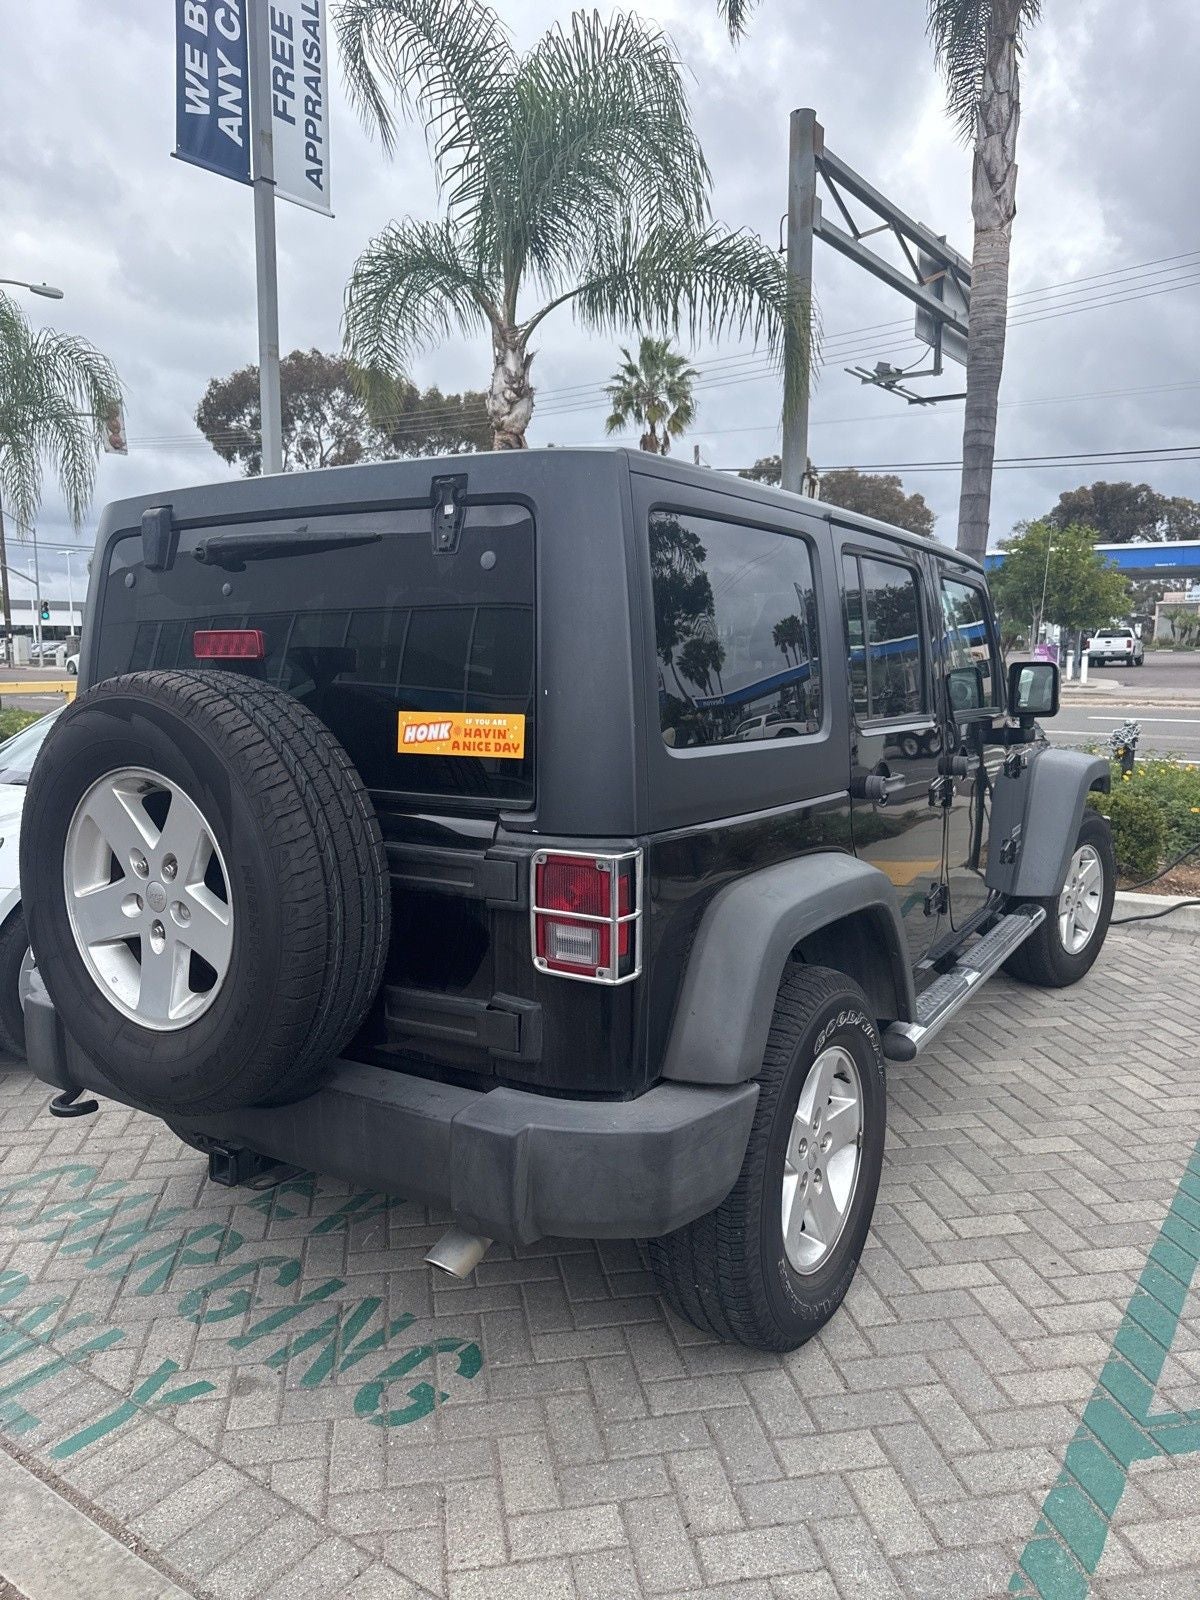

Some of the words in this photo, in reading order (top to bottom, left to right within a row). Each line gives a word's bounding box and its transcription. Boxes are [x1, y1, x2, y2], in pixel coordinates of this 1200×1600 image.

[183, 0, 208, 37] B
[184, 43, 210, 115] WE
[270, 5, 296, 126] FREE
[216, 48, 243, 147] ANY
[403, 721, 453, 744] HONK
[451, 741, 461, 751] A
[462, 741, 491, 752] NICE
[494, 742, 520, 753] DAY
[463, 728, 510, 739] HAVIN'
[0, 1164, 483, 1427] CHARGING
